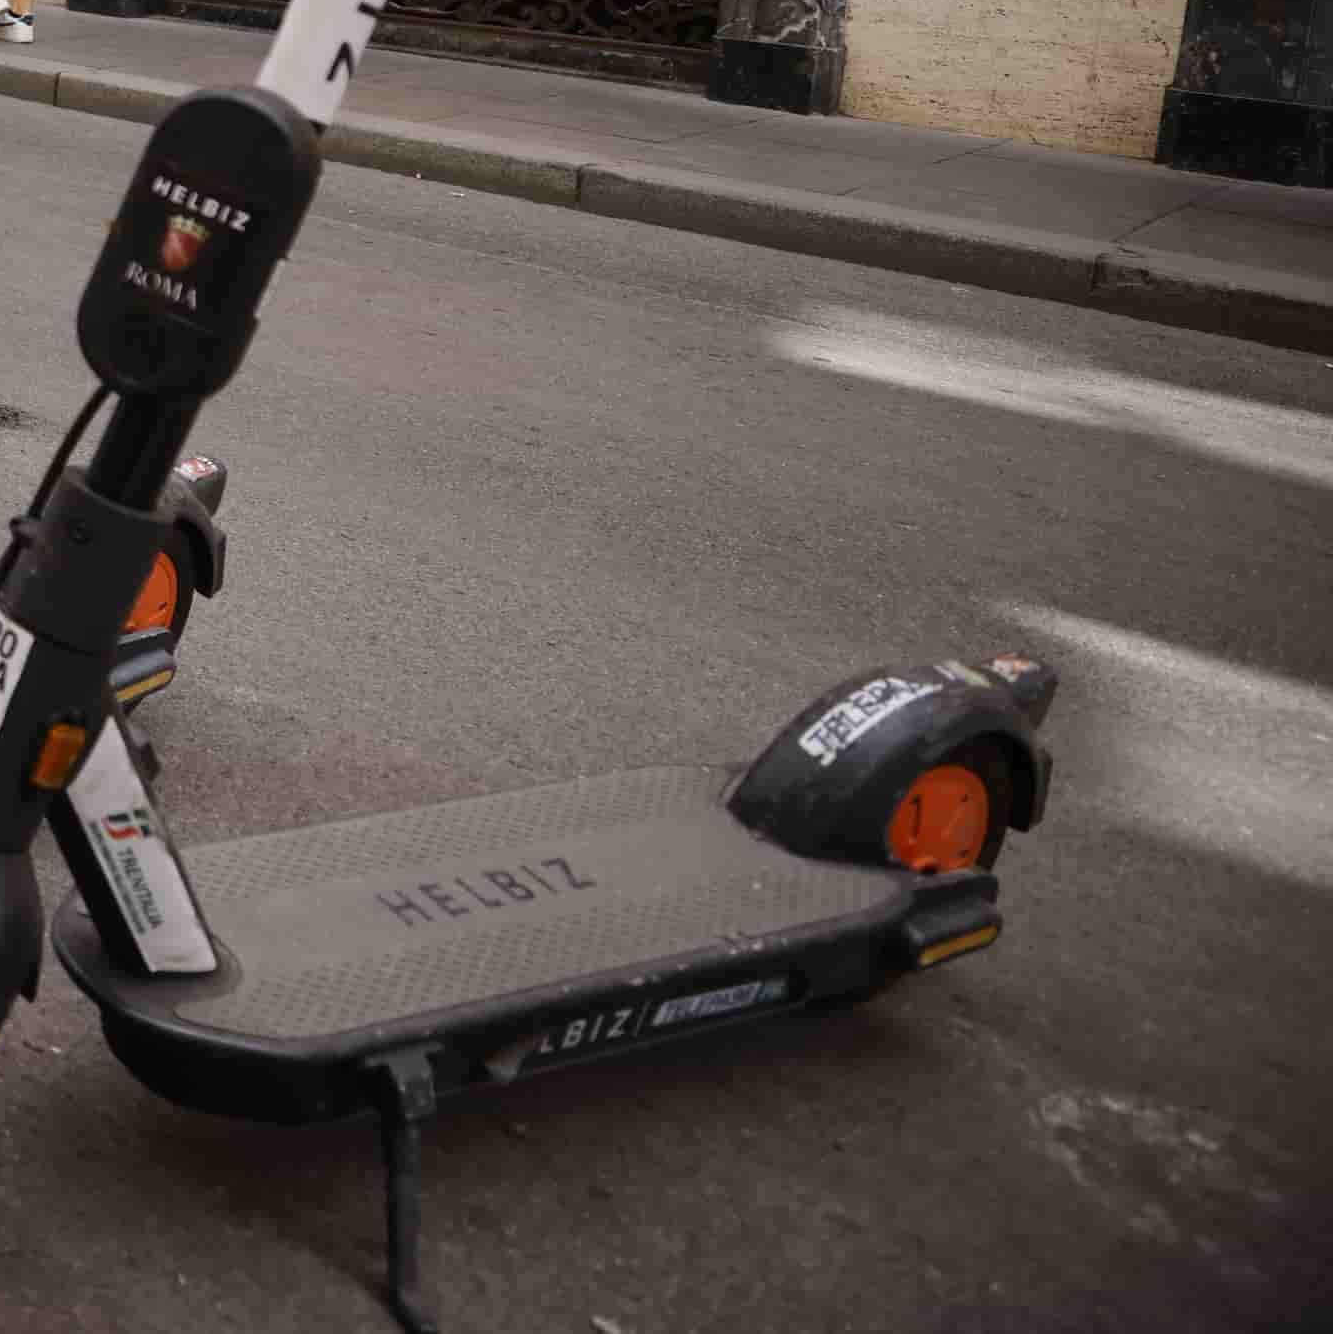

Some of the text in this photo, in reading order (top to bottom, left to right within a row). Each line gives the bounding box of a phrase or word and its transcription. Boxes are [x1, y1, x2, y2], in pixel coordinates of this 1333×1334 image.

[151, 175, 251, 233] HELBIZ
[125, 260, 199, 311] ROMA
[374, 857, 598, 928] HELBIZ
